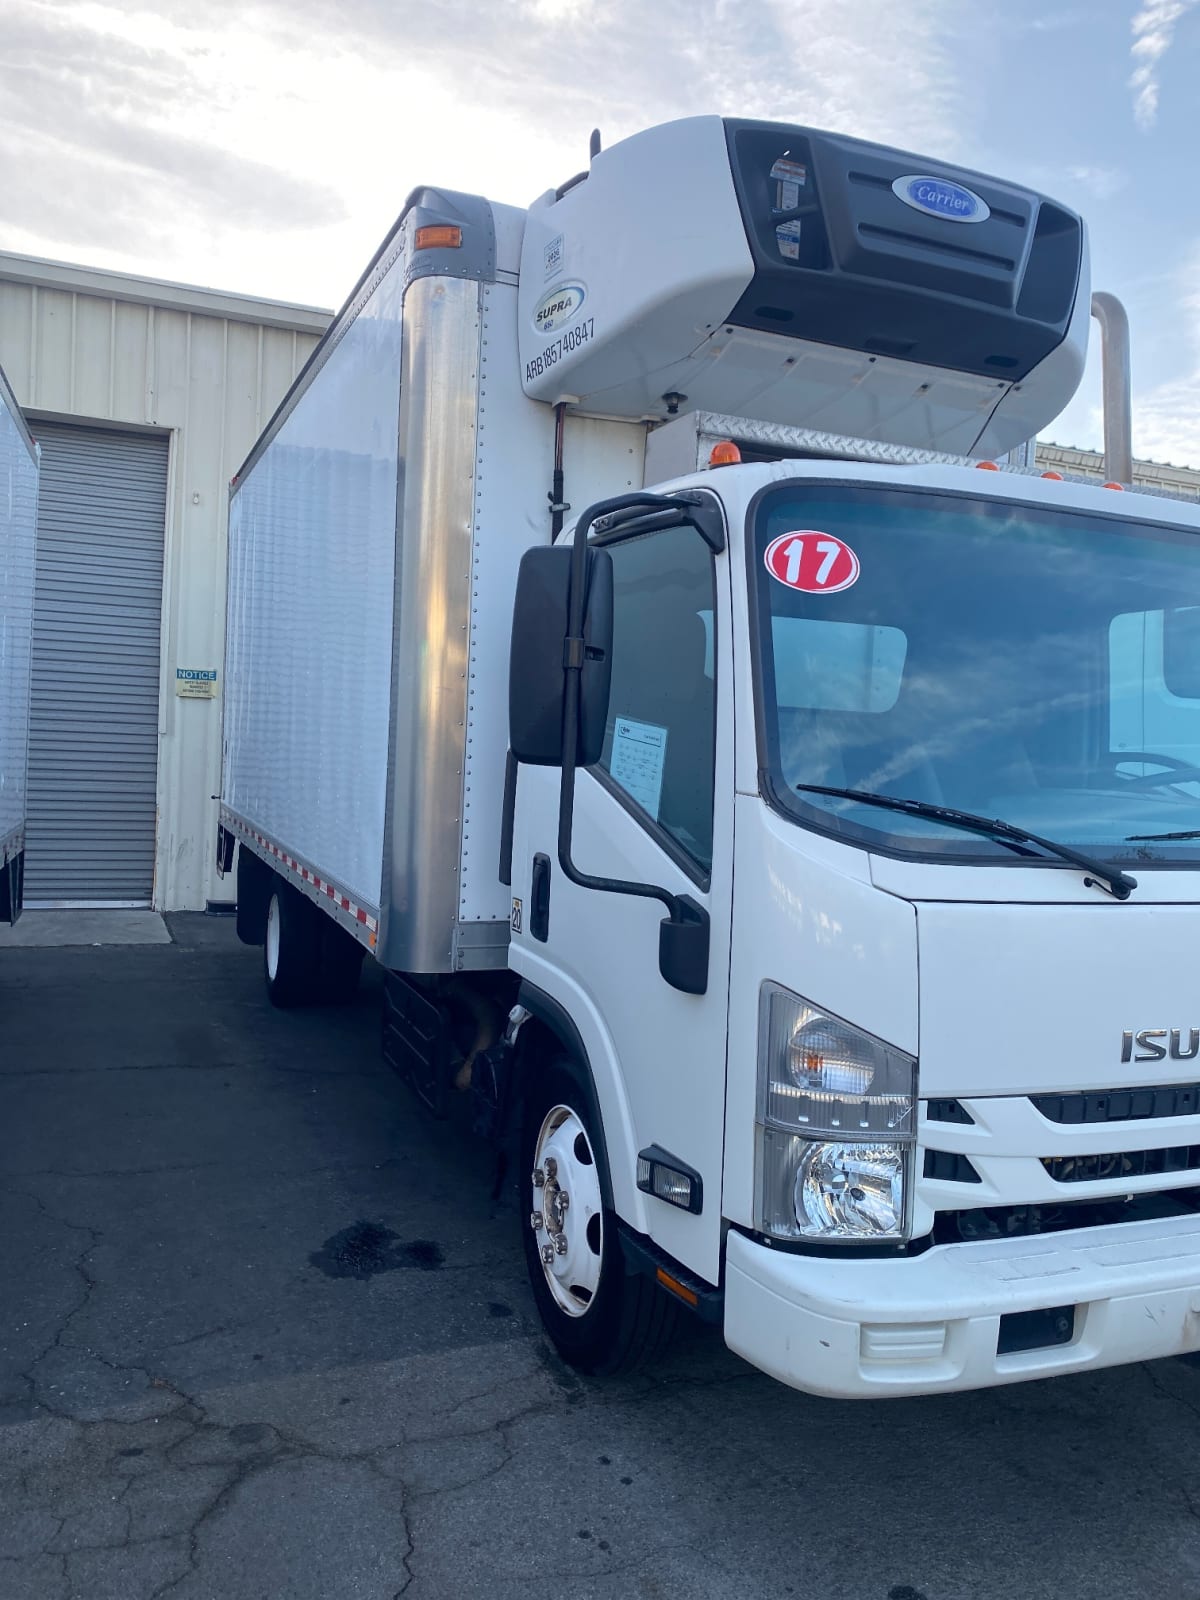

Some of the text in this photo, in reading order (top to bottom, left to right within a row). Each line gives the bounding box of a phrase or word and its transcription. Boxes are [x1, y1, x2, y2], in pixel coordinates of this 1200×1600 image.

[918, 185, 970, 211] Carrier
[536, 296, 573, 322] SUPRA
[526, 317, 595, 382] ARB185740847
[783, 539, 841, 585] 17
[178, 670, 215, 680] NOTICE
[512, 907, 521, 930] 20
